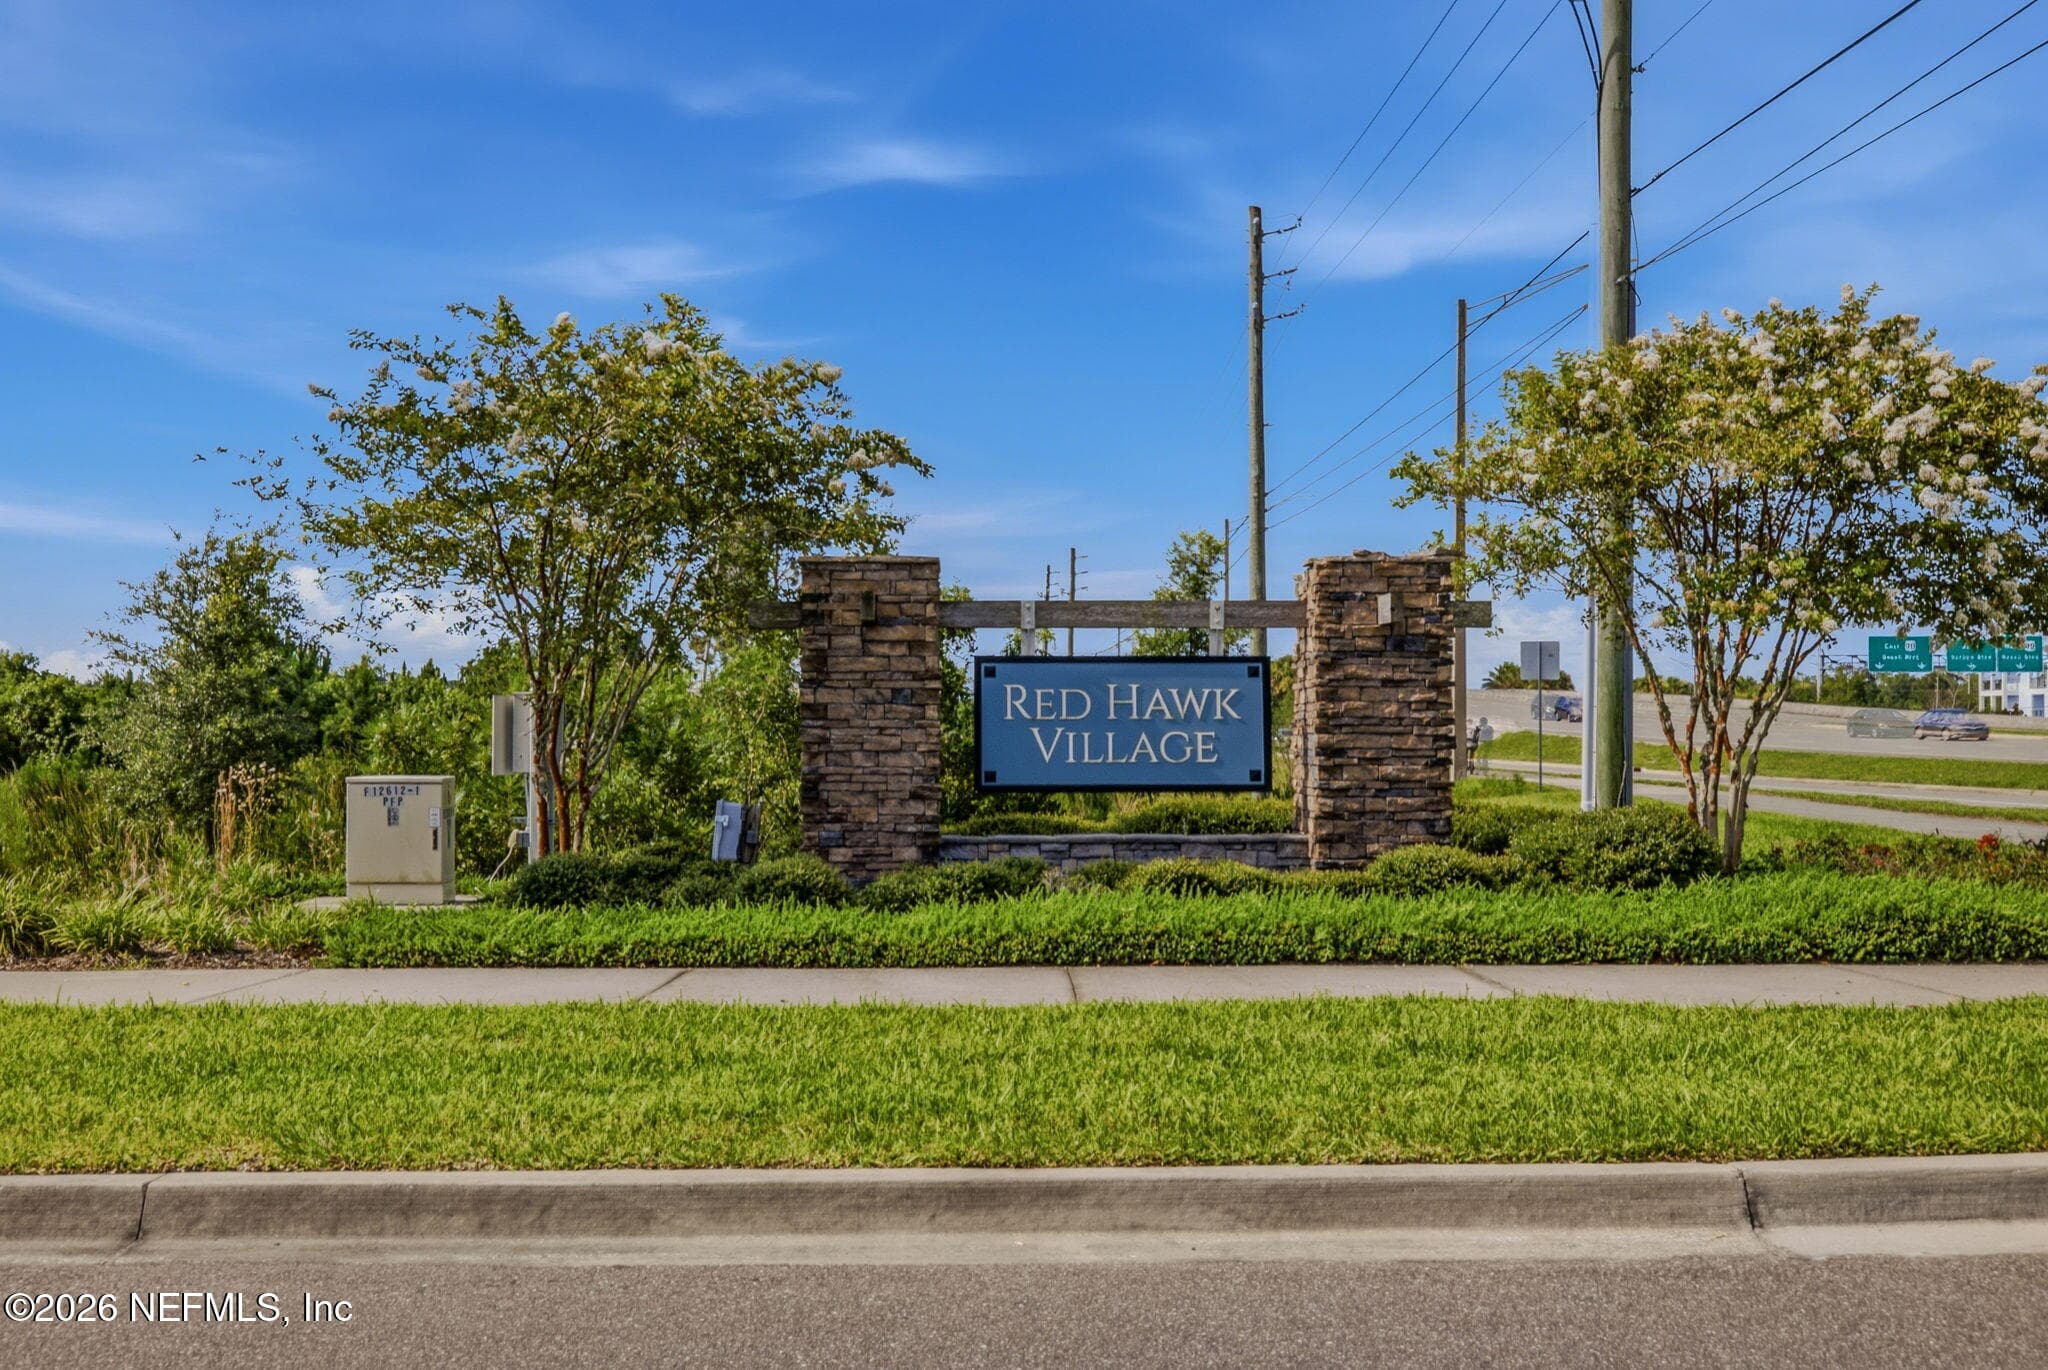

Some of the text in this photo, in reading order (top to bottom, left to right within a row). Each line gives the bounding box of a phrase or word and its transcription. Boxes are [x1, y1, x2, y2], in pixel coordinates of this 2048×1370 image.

[1003, 683, 1243, 721] RED HAWK
[1029, 726, 1219, 764] VILLAGE
[383, 796, 403, 807] PFP
